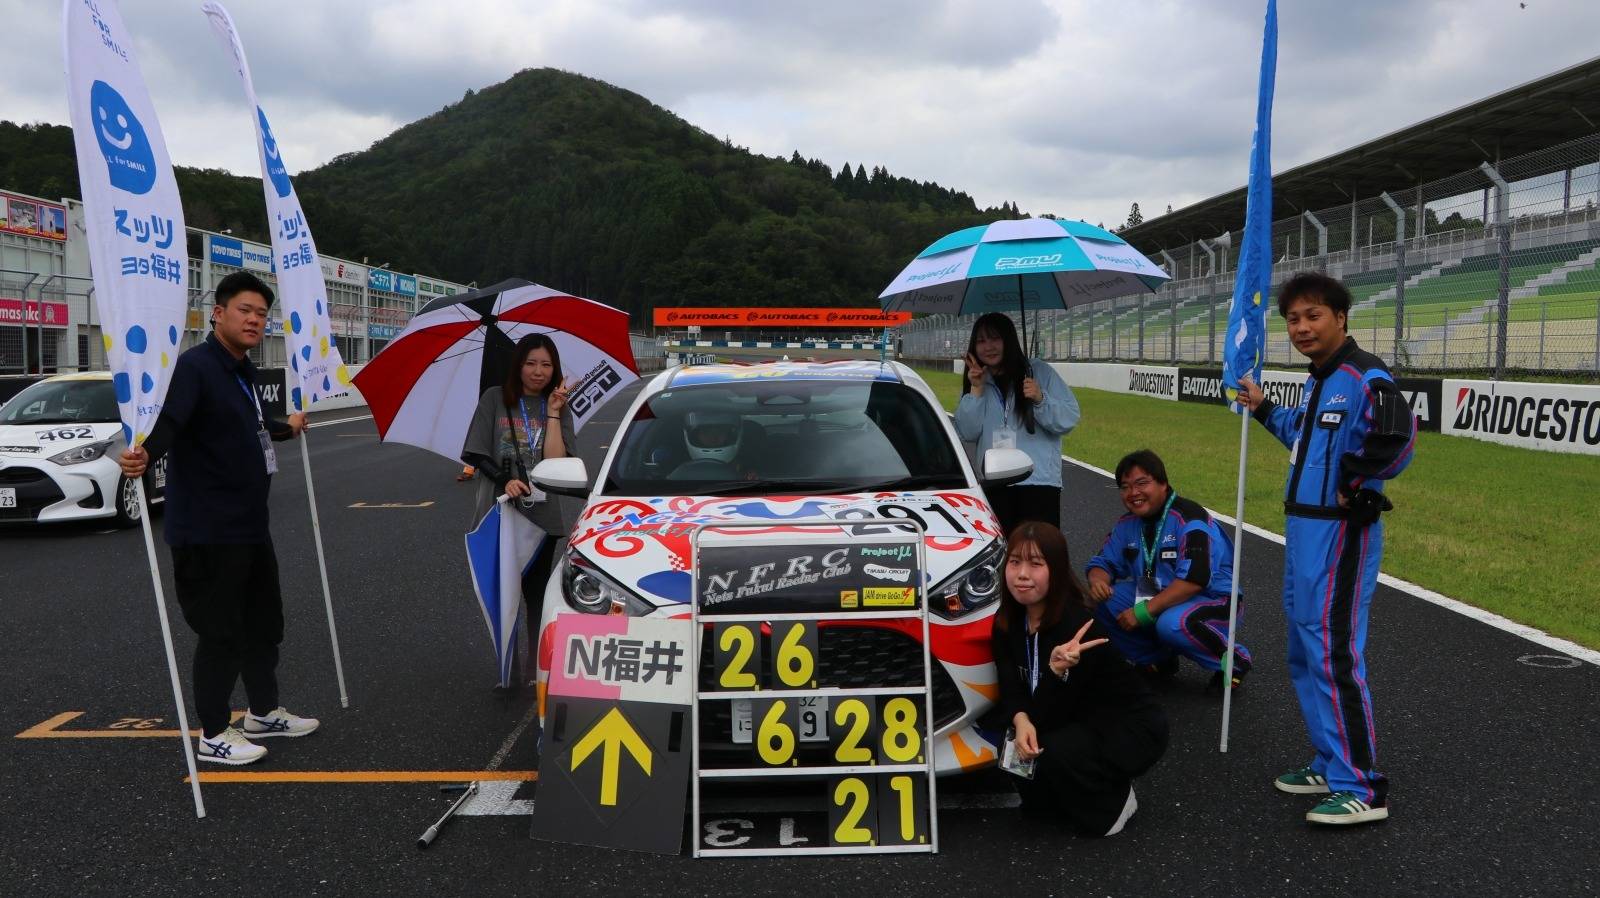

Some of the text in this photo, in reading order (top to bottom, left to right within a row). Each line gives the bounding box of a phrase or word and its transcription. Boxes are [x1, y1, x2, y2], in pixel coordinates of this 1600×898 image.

[212, 244, 227, 255] TOYO
[244, 251, 257, 262] TOYO
[840, 313, 899, 321] AUTOBACS
[1128, 369, 1175, 396] BRIDGESTONE
[39, 428, 94, 441] 462
[834, 503, 968, 536] 291
[775, 572, 821, 590] Racing
[822, 563, 852, 579] Club
[567, 638, 684, 685] N福井
